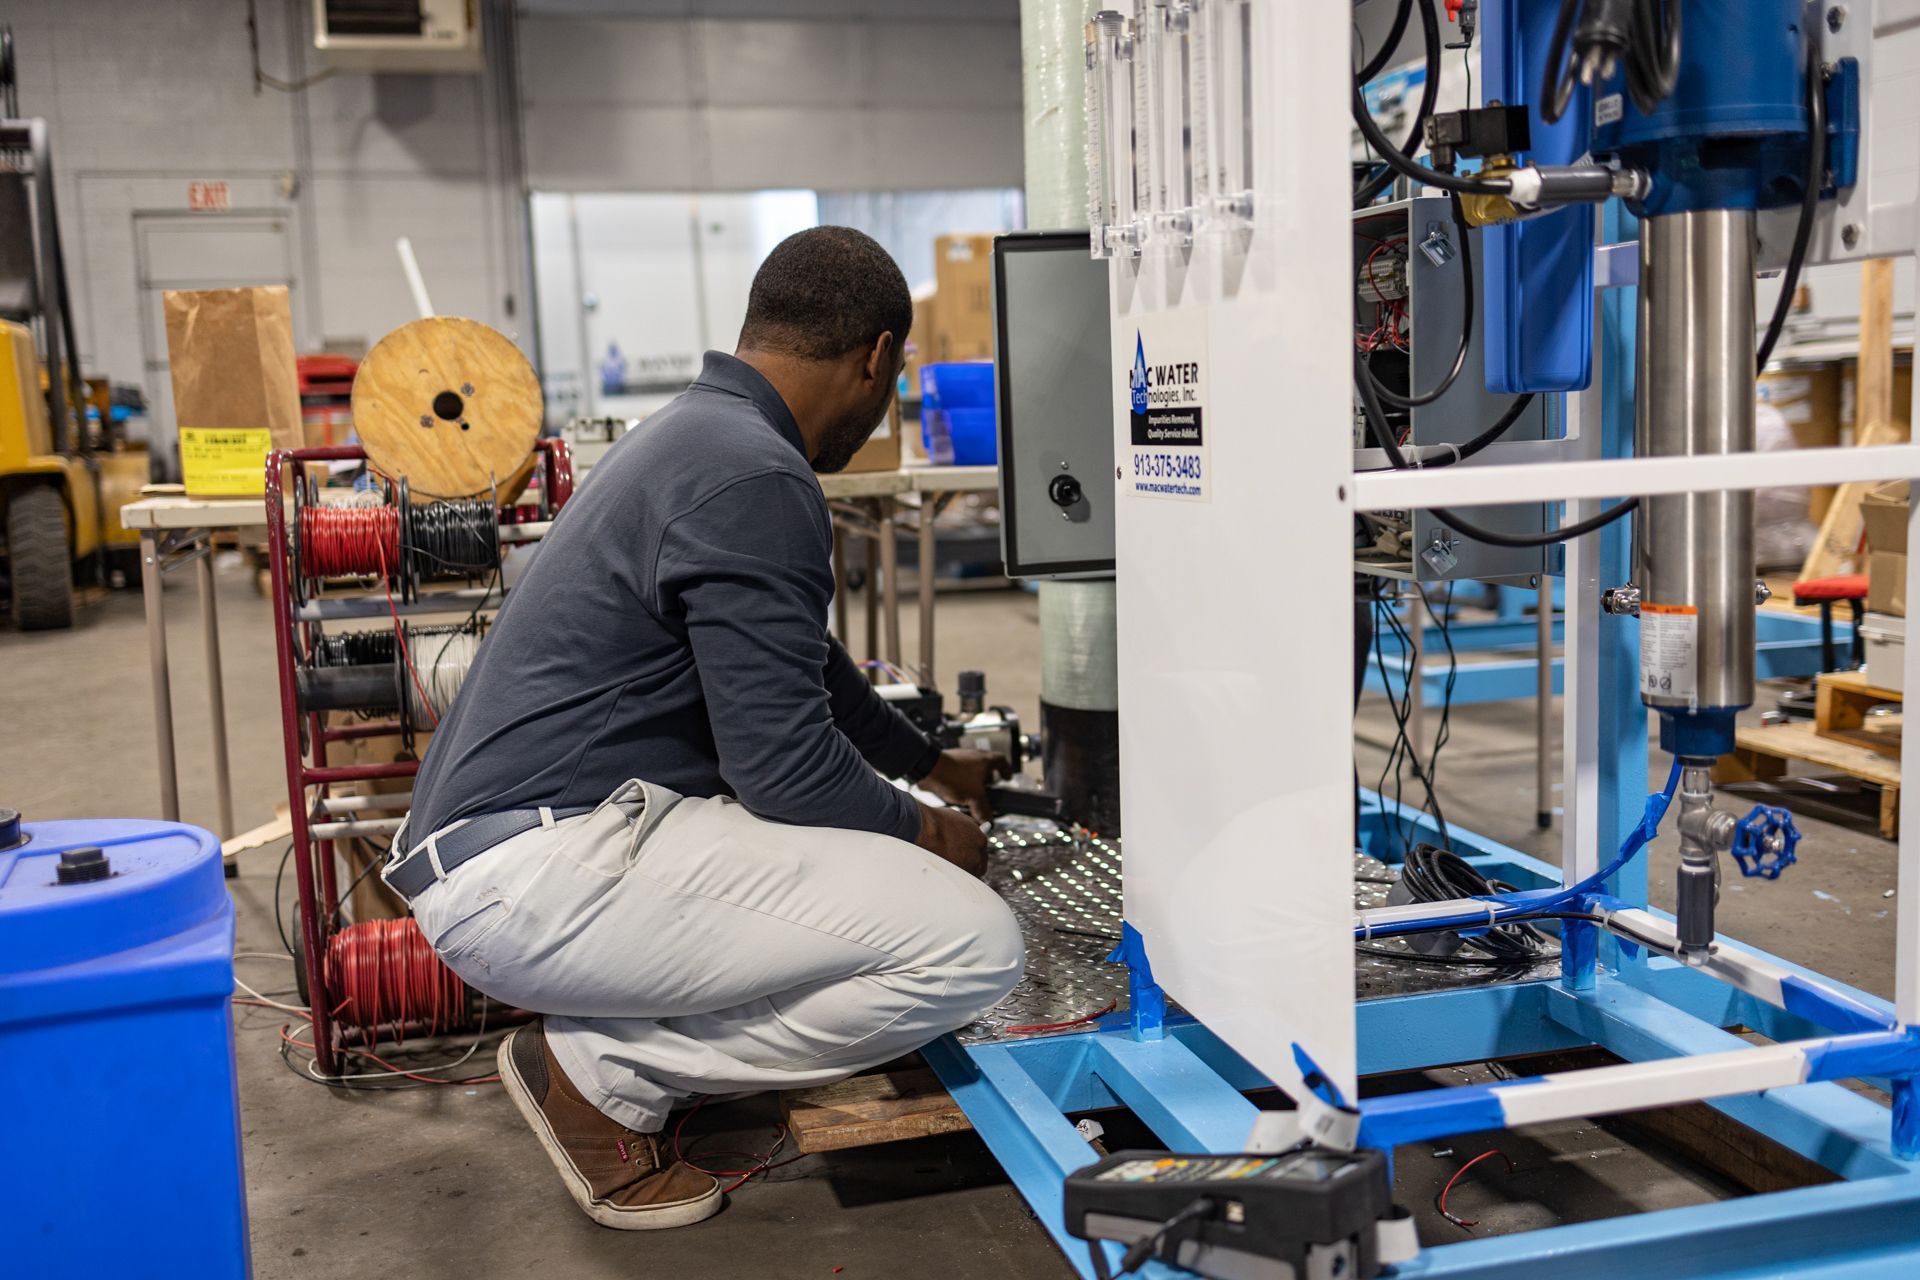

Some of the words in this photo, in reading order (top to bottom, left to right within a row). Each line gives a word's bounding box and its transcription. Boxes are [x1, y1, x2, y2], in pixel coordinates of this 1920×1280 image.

[189, 182, 228, 211] EXIT
[1129, 367, 1153, 389] MAC
[1155, 362, 1199, 387] WATER
[1132, 388, 1181, 407] Technologies,
[1183, 386, 1198, 402] Inc.
[1148, 415, 1171, 426] Impurities
[1147, 429, 1164, 440] Quality
[1164, 429, 1181, 439] Service
[1134, 453, 1201, 479] 913-375-3483
[1135, 482, 1201, 496] www.macwatertech.com
